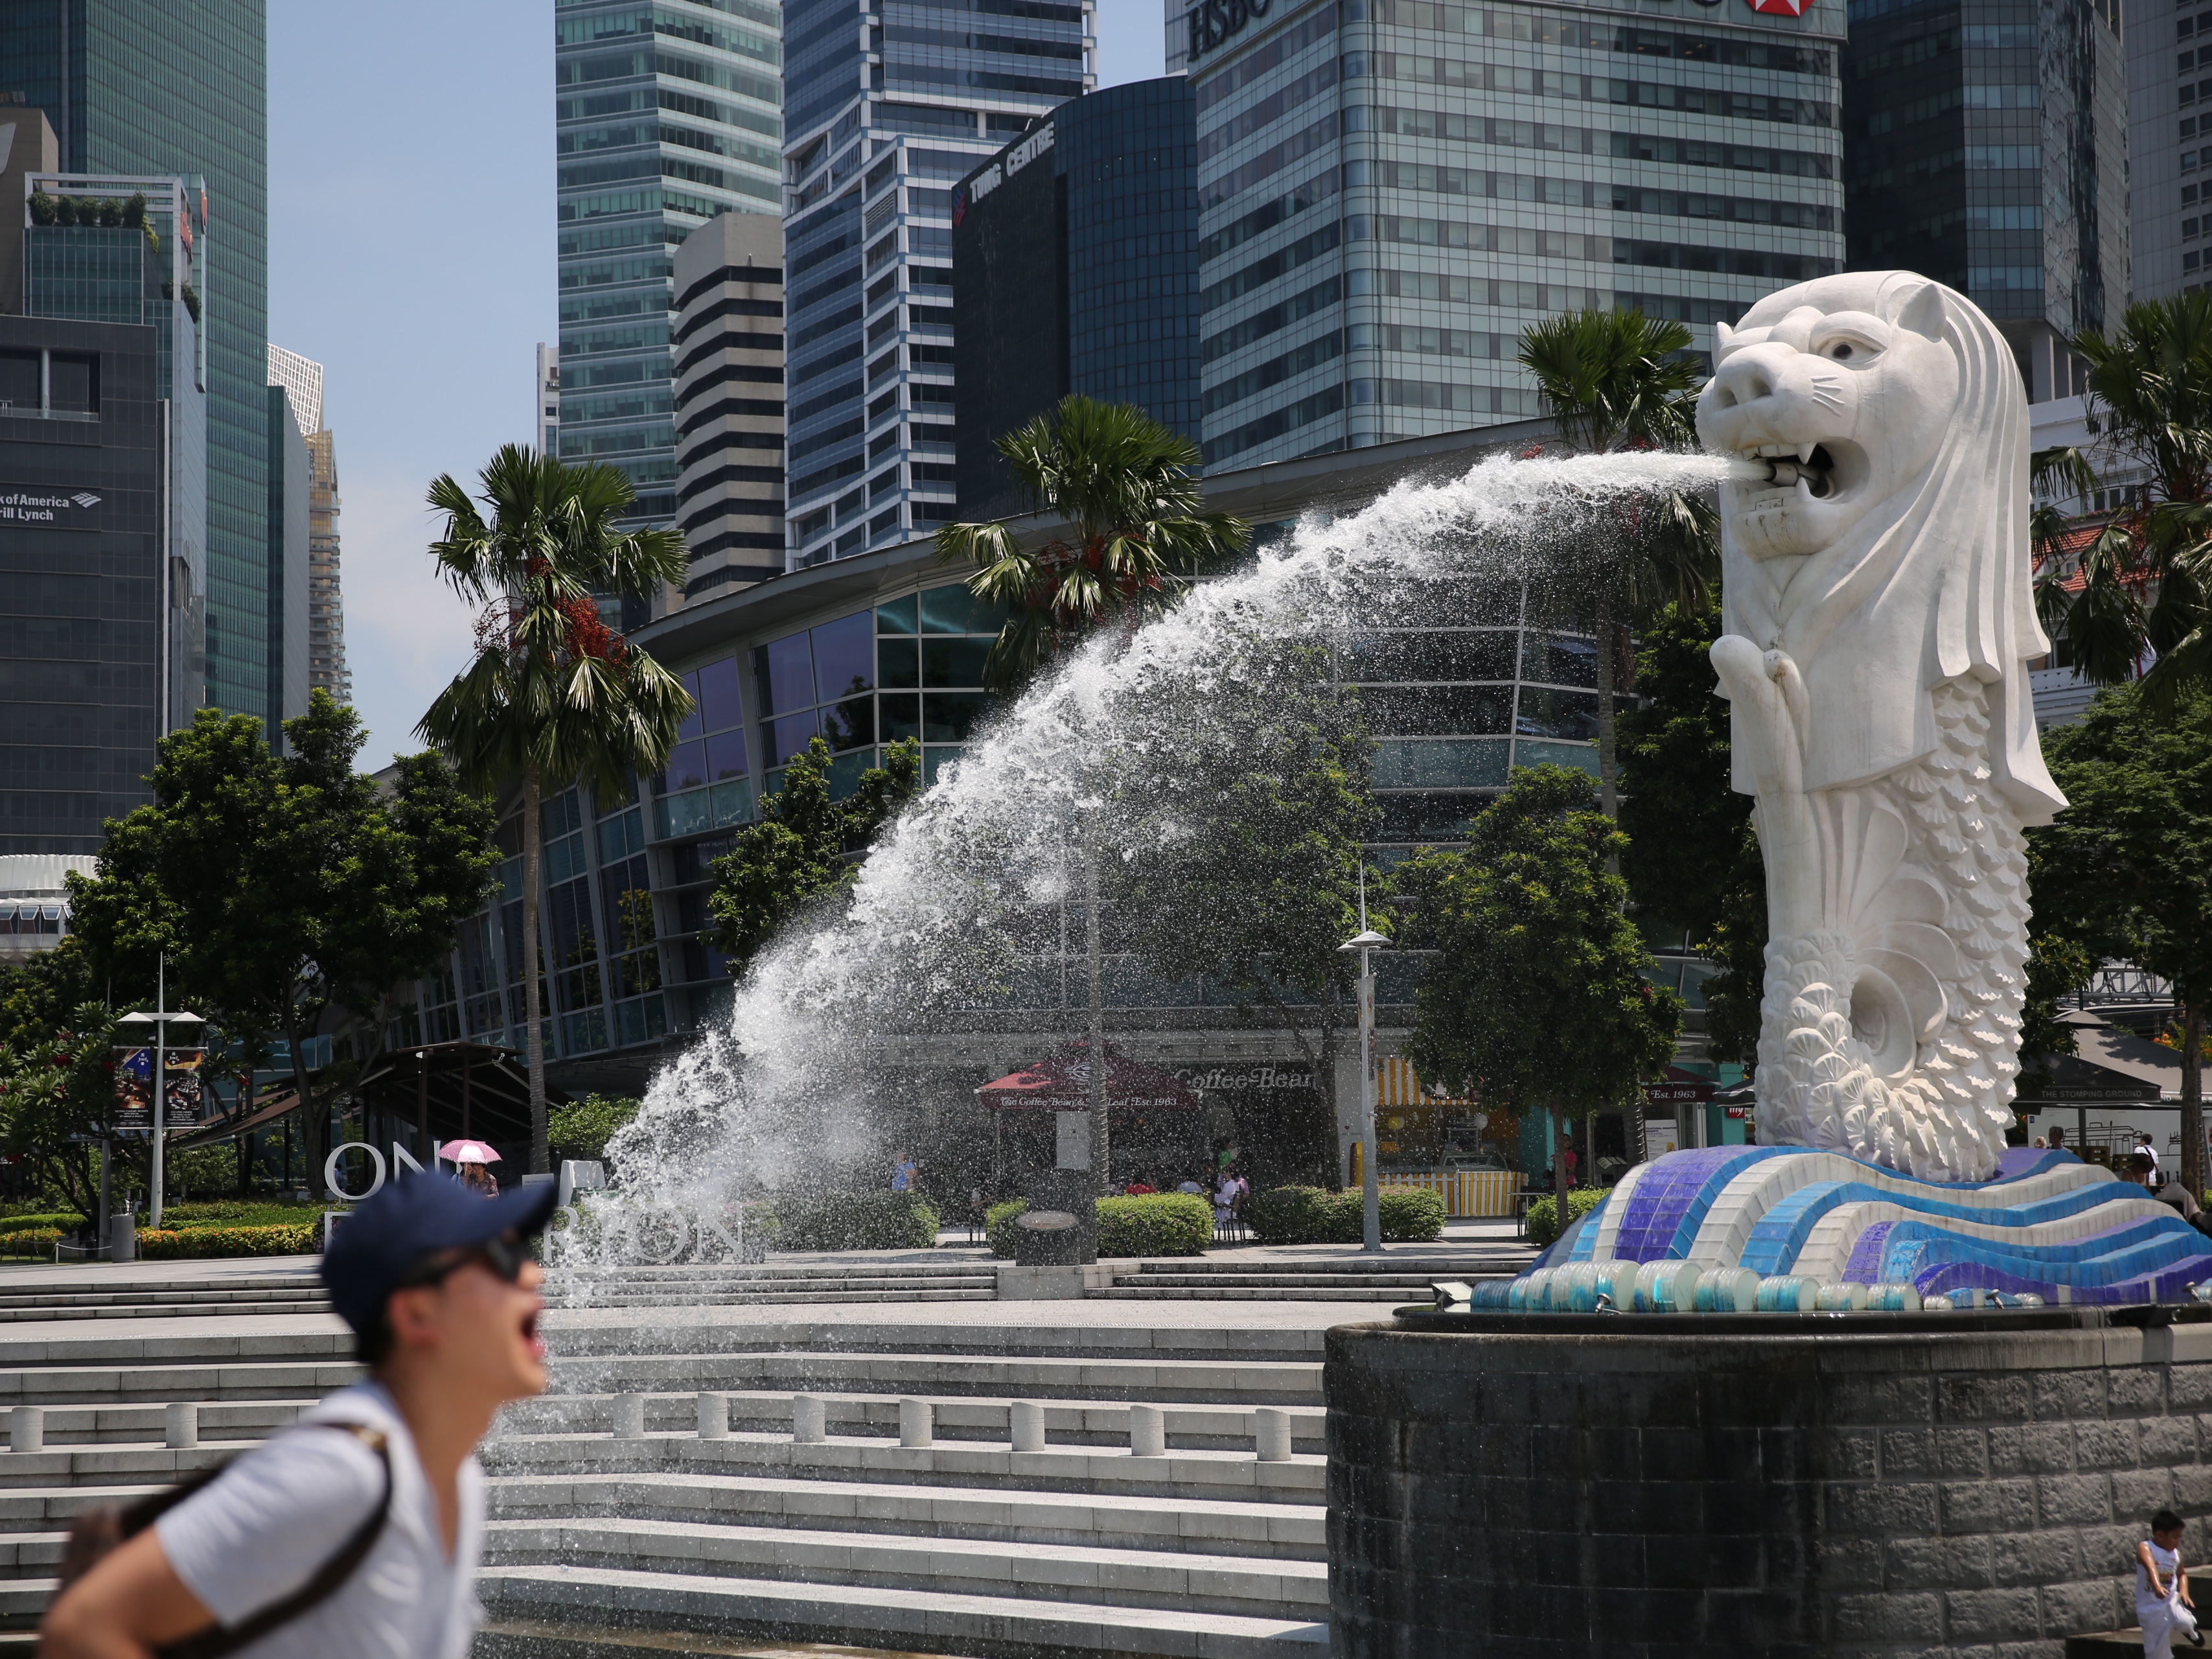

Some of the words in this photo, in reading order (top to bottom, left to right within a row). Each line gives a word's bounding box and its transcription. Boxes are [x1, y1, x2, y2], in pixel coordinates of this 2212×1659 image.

[970, 163, 1001, 203] TUNG
[1006, 121, 1054, 176] CENTRE
[6, 494, 19, 505] of
[19, 494, 69, 507] America
[18, 508, 53, 521] Lynch
[1650, 1090, 1670, 1098] Est.
[1673, 1090, 1696, 1098] 1963
[1000, 1097, 1017, 1107] The
[1019, 1097, 1048, 1106] Coffee
[1048, 1097, 1076, 1108] Bean
[1107, 1097, 1129, 1106] Leaf
[1153, 1098, 1177, 1106] 1963
